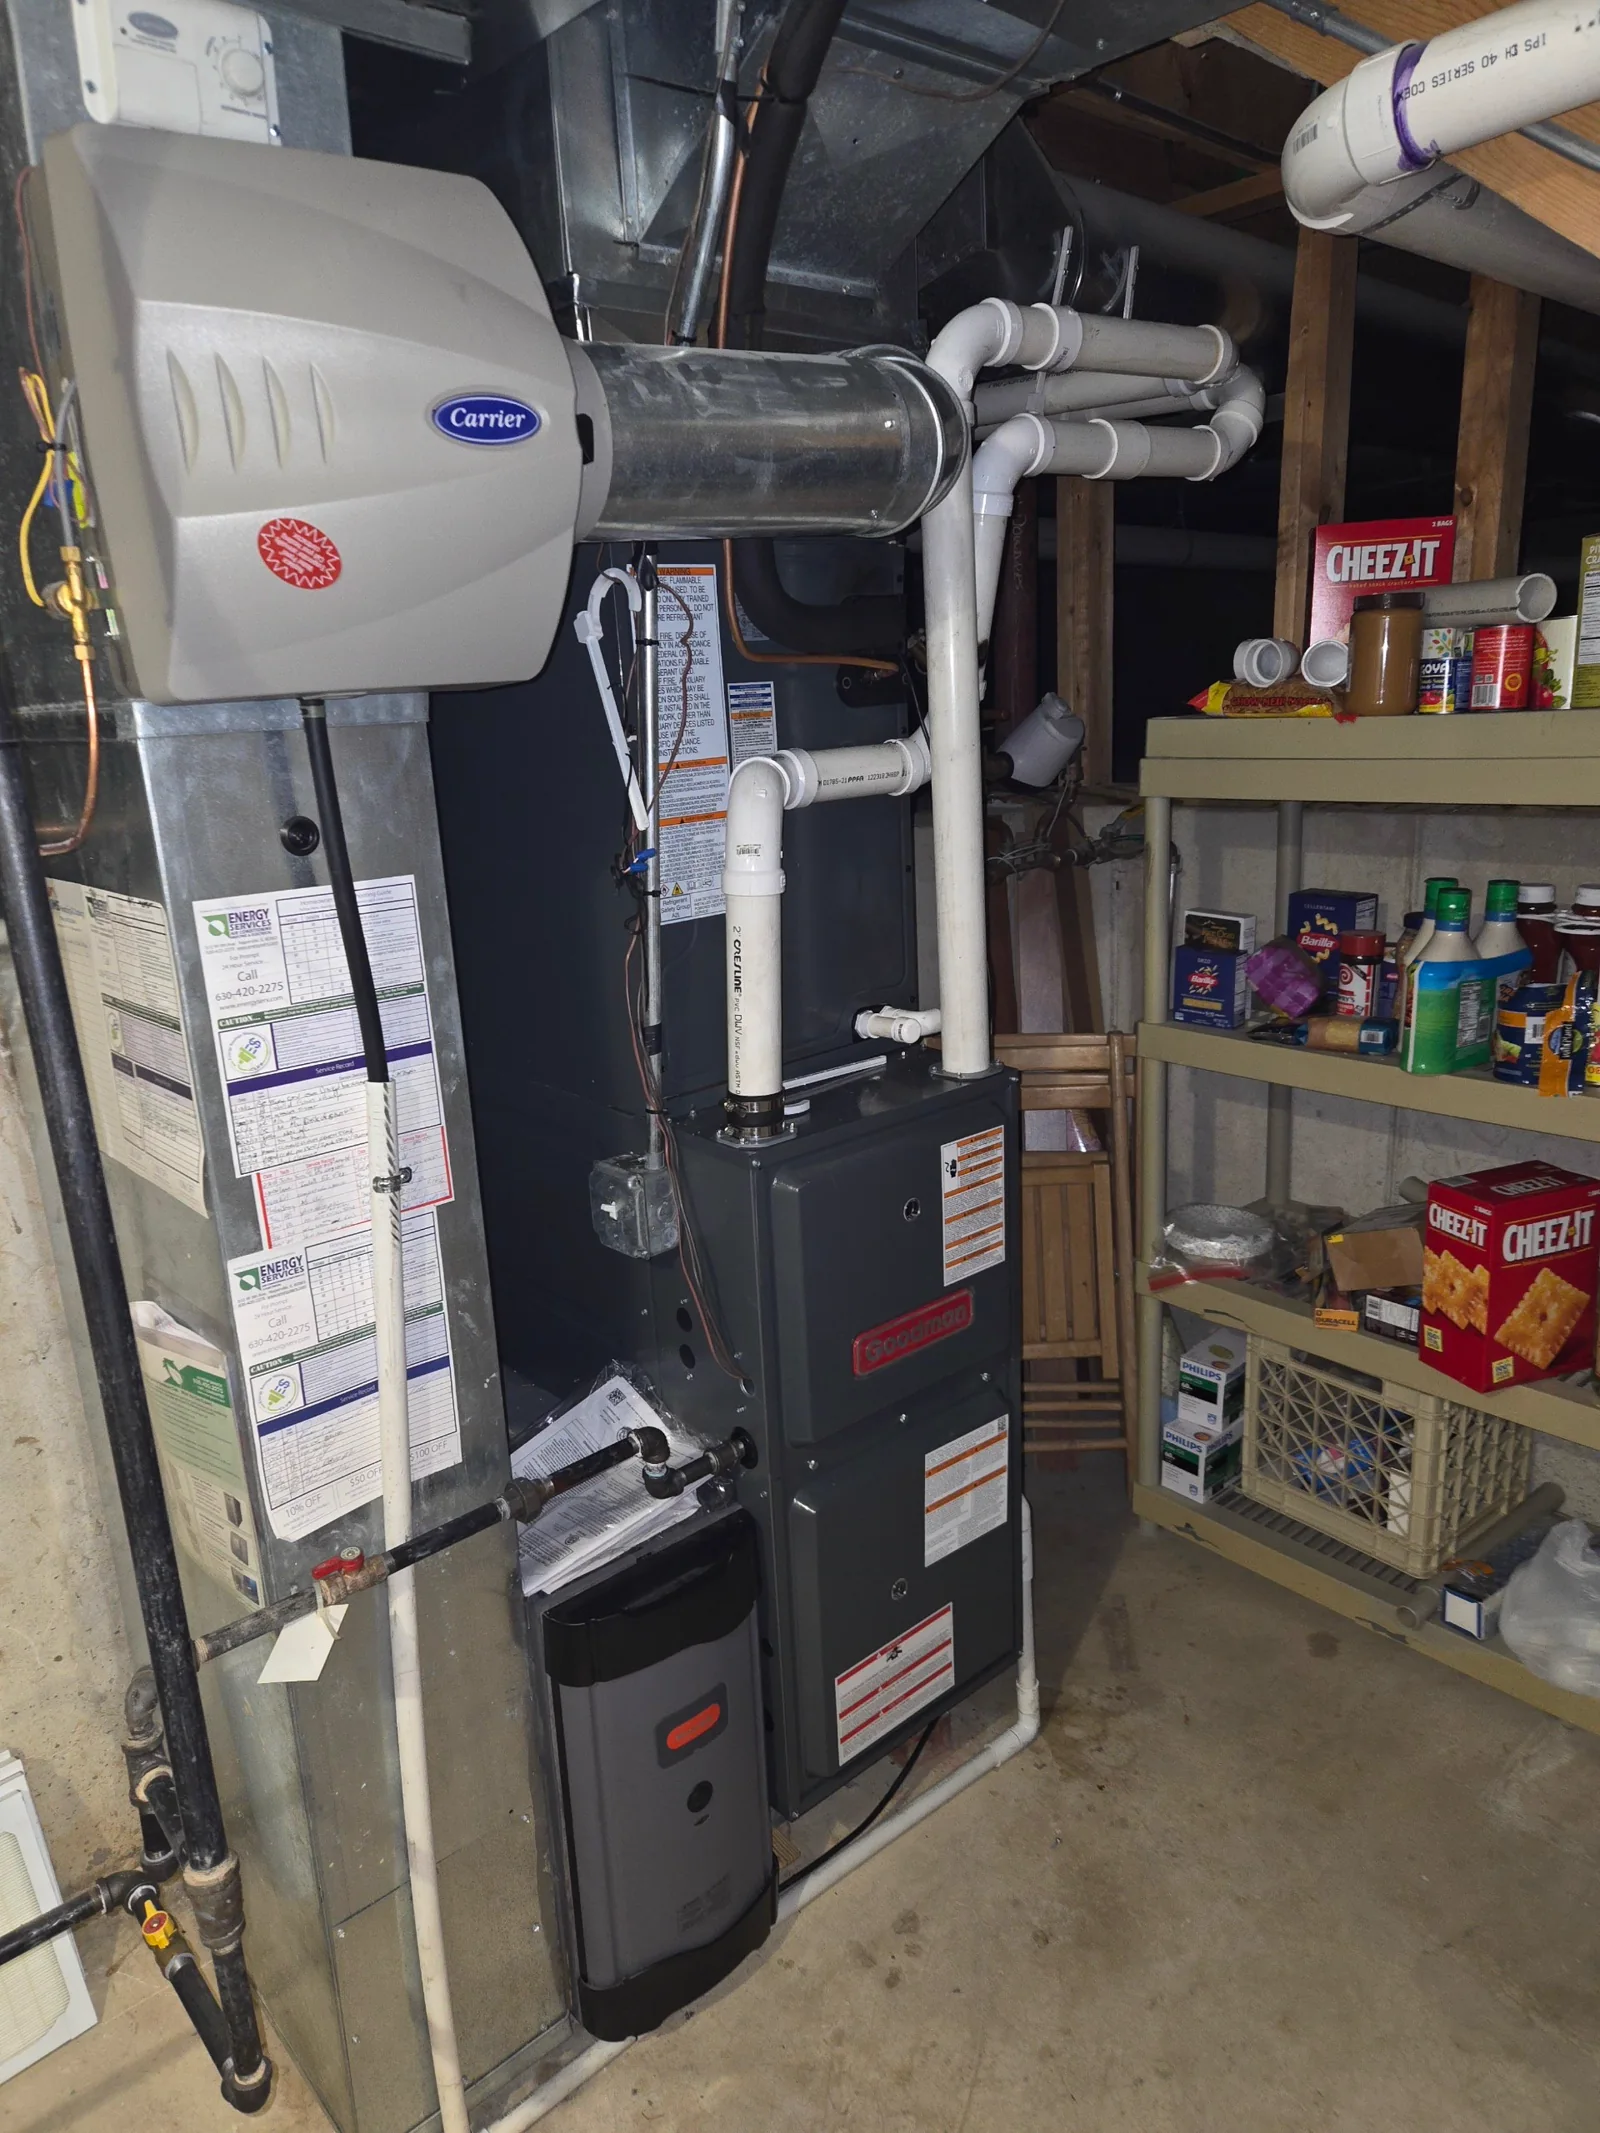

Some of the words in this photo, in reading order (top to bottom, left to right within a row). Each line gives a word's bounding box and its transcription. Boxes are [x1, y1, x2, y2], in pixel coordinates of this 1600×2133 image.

[1525, 32, 1547, 53] IPS
[1481, 54, 1498, 69] 40
[1431, 61, 1475, 89] SERIES
[450, 407, 526, 429] Carrier
[1437, 519, 1453, 528] BAGS
[1326, 539, 1440, 582] CHEEZ-IT
[660, 567, 691, 575] WARNING
[670, 576, 702, 584] FLAMMABLE
[690, 585, 698, 593] TO
[699, 585, 706, 593] BE
[687, 594, 709, 603] TRAINED
[694, 604, 704, 612] DO
[666, 612, 703, 622] REFRIGANT
[675, 631, 700, 639] DISPSE
[675, 639, 711, 648] ACCRDANCE
[679, 676, 706, 684] AXILIARY
[697, 684, 705, 692] BE
[667, 694, 694, 703] SOURES
[694, 693, 711, 701] SHALL
[664, 703, 693, 712] INSTALED
[677, 712, 696, 720] OHER
[696, 710, 711, 718] THAN
[673, 721, 696, 729] DECES
[697, 719, 715, 727] LISTED
[670, 730, 683, 738] WIT
[684, 729, 696, 737] THE
[662, 897, 689, 906] Refrigerant
[228, 908, 270, 924] ENERGY
[229, 919, 272, 931] SERVICES
[1301, 935, 1336, 948] Barilla
[237, 969, 258, 982] Call
[1191, 975, 1217, 985] Barilla
[215, 981, 284, 1002] 630-420-2275
[733, 1013, 743, 1036] DWV
[315, 1064, 335, 1075] Service
[335, 1060, 355, 1072] Record
[260, 1254, 303, 1277] ENERGY
[261, 1265, 305, 1284] SERVICES
[268, 1314, 288, 1329] Call
[1316, 1317, 1356, 1326] DURACELL
[248, 1322, 311, 1350] 630-420-2275
[865, 1304, 967, 1362] Goodman
[1182, 1361, 1222, 1381] PHILIPS
[339, 1391, 360, 1403] Service
[359, 1384, 376, 1397] Record
[1165, 1431, 1203, 1453] PHILIPS
[409, 1447, 430, 1462] $100
[431, 1440, 448, 1453] OFF
[349, 1473, 365, 1488] $50
[285, 1504, 304, 1518] 10%
[304, 1493, 322, 1509] OFF
